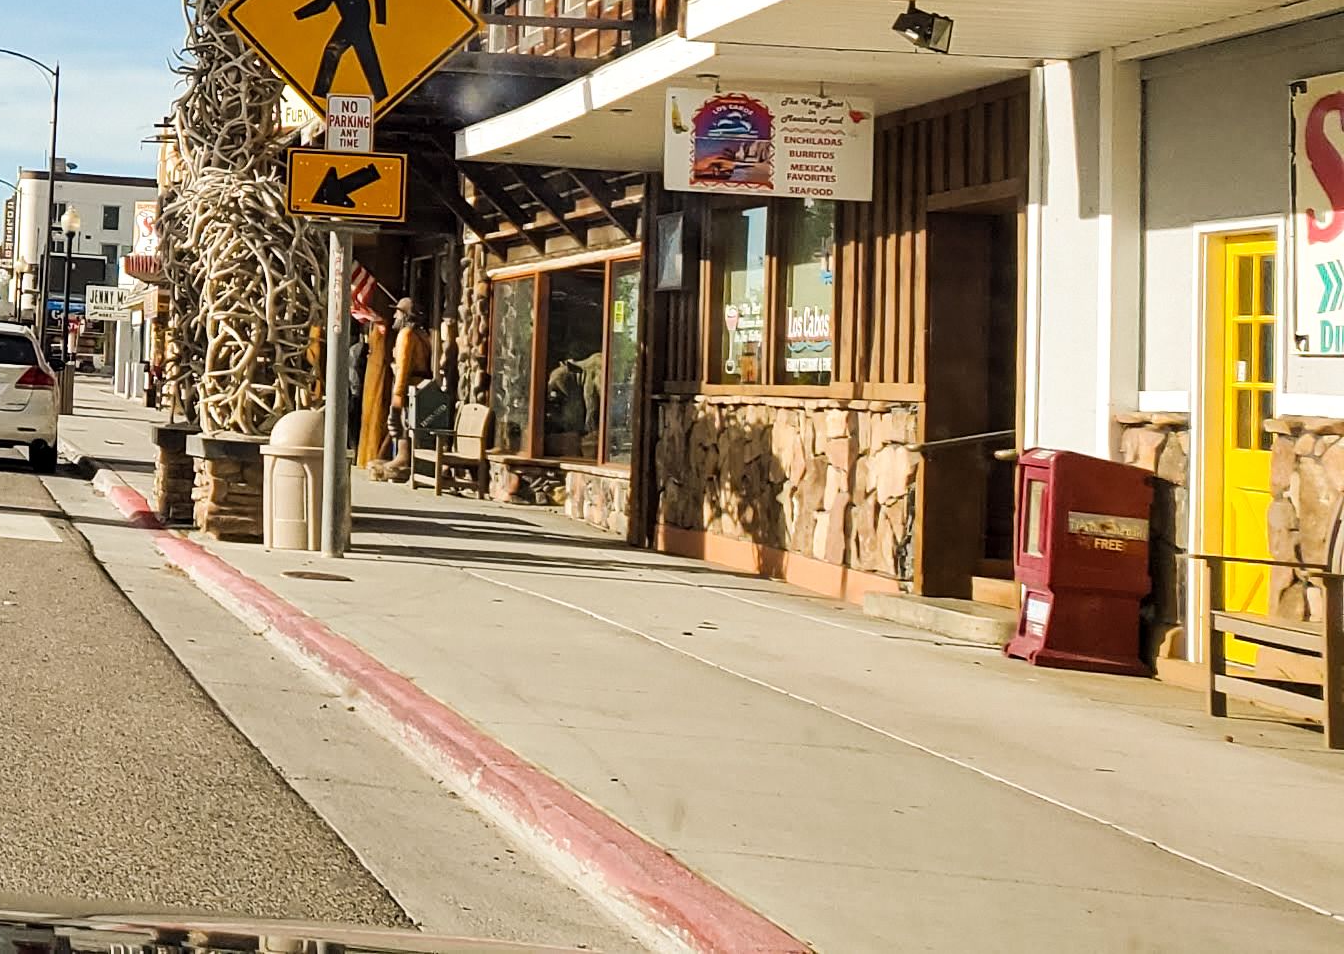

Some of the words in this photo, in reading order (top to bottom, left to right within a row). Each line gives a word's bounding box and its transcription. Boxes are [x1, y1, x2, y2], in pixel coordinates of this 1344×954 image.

[341, 100, 358, 113] NO
[328, 114, 370, 129] PARKING
[340, 128, 358, 138] ANY
[339, 138, 359, 148] TIME
[783, 136, 843, 146] ENCHILADAS
[789, 149, 835, 159] BURRITOS
[790, 163, 833, 173] MEXICAN
[786, 173, 837, 183] FAVORITES
[788, 186, 834, 196] SEAFOOD
[90, 290, 114, 304] JENNY
[787, 306, 803, 338] Los
[803, 305, 830, 338] Cabos
[1094, 538, 1124, 551] FREE
